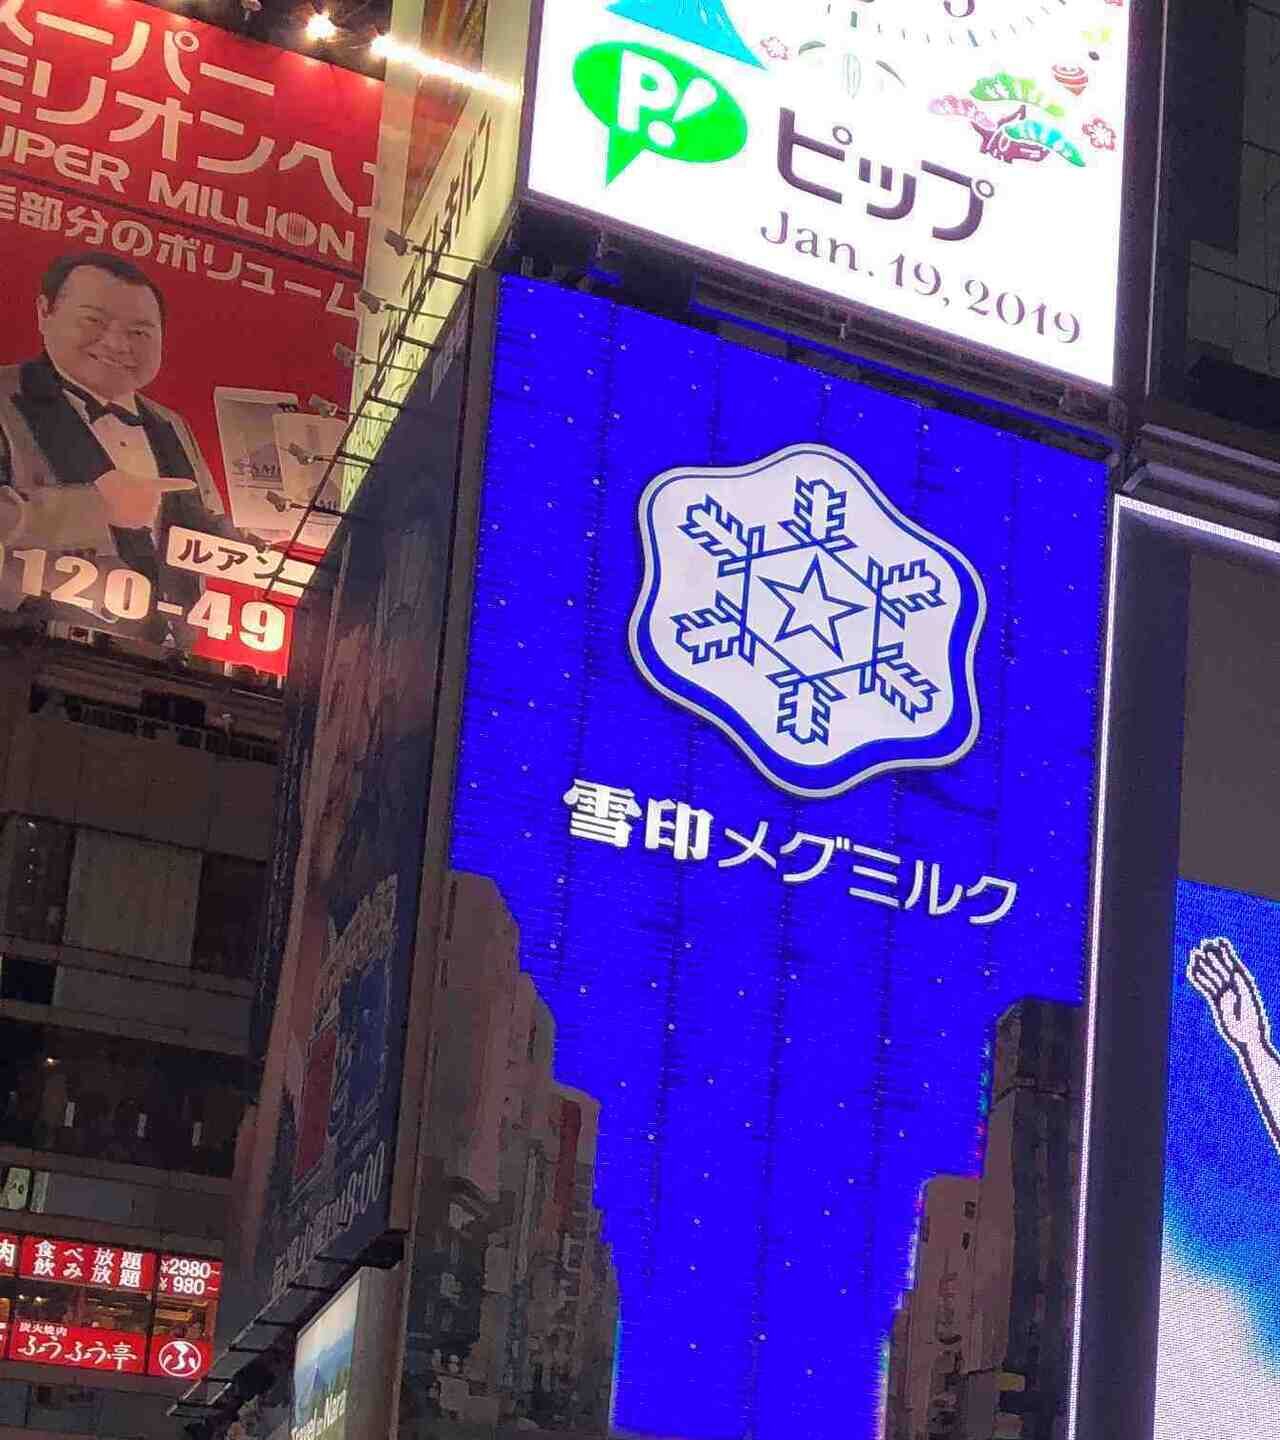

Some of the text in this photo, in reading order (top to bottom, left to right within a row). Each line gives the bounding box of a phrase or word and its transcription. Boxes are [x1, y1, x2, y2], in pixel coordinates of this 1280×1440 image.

[149, 170, 356, 263] MILLION
[777, 107, 995, 241] ピップ
[562, 777, 1018, 925] 雪印メグミルク
[33, 1258, 142, 1288] 飲み放題
[34, 1239, 143, 1269] 食べ放題
